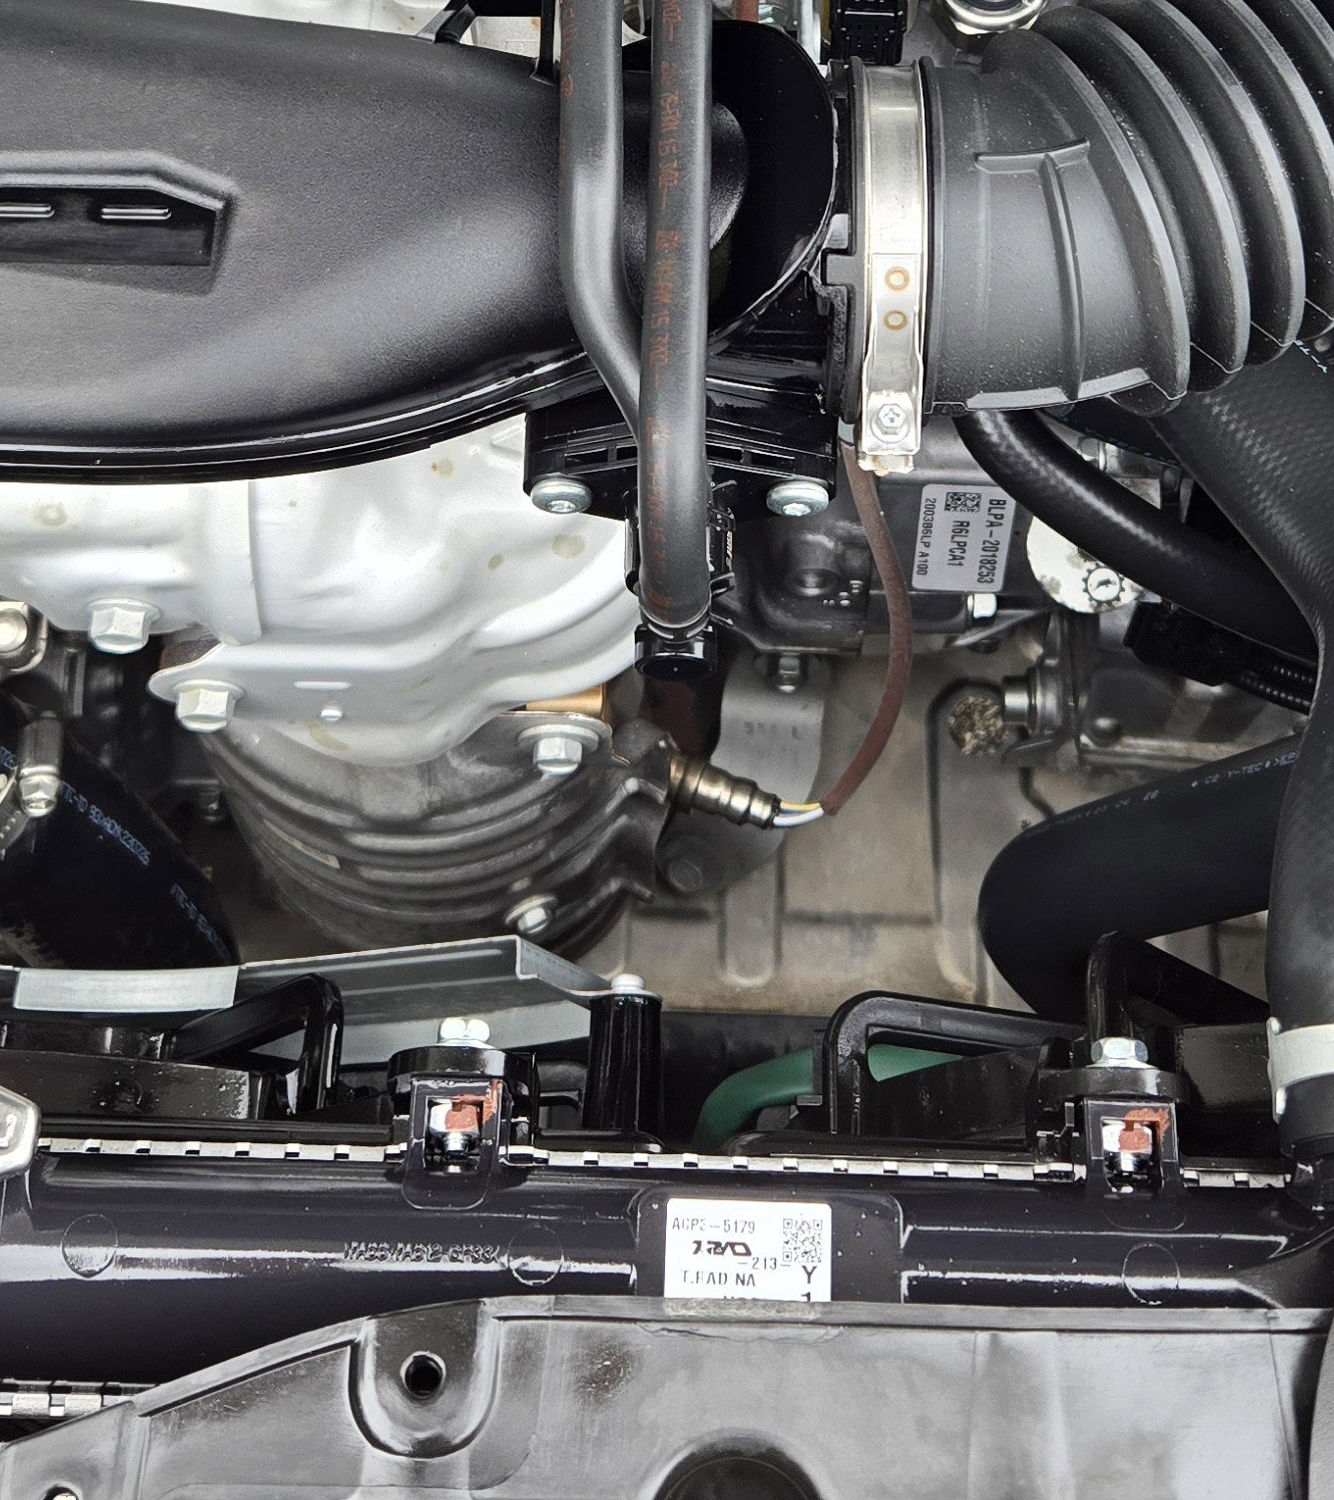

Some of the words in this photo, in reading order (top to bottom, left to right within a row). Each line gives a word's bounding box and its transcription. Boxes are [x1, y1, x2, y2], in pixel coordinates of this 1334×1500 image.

[920, 498, 936, 548] 2003B6LP
[948, 520, 970, 567] R6LPCA1
[916, 551, 929, 576] A100
[735, 1272, 756, 1287] NA
[801, 1266, 817, 1284] Y
